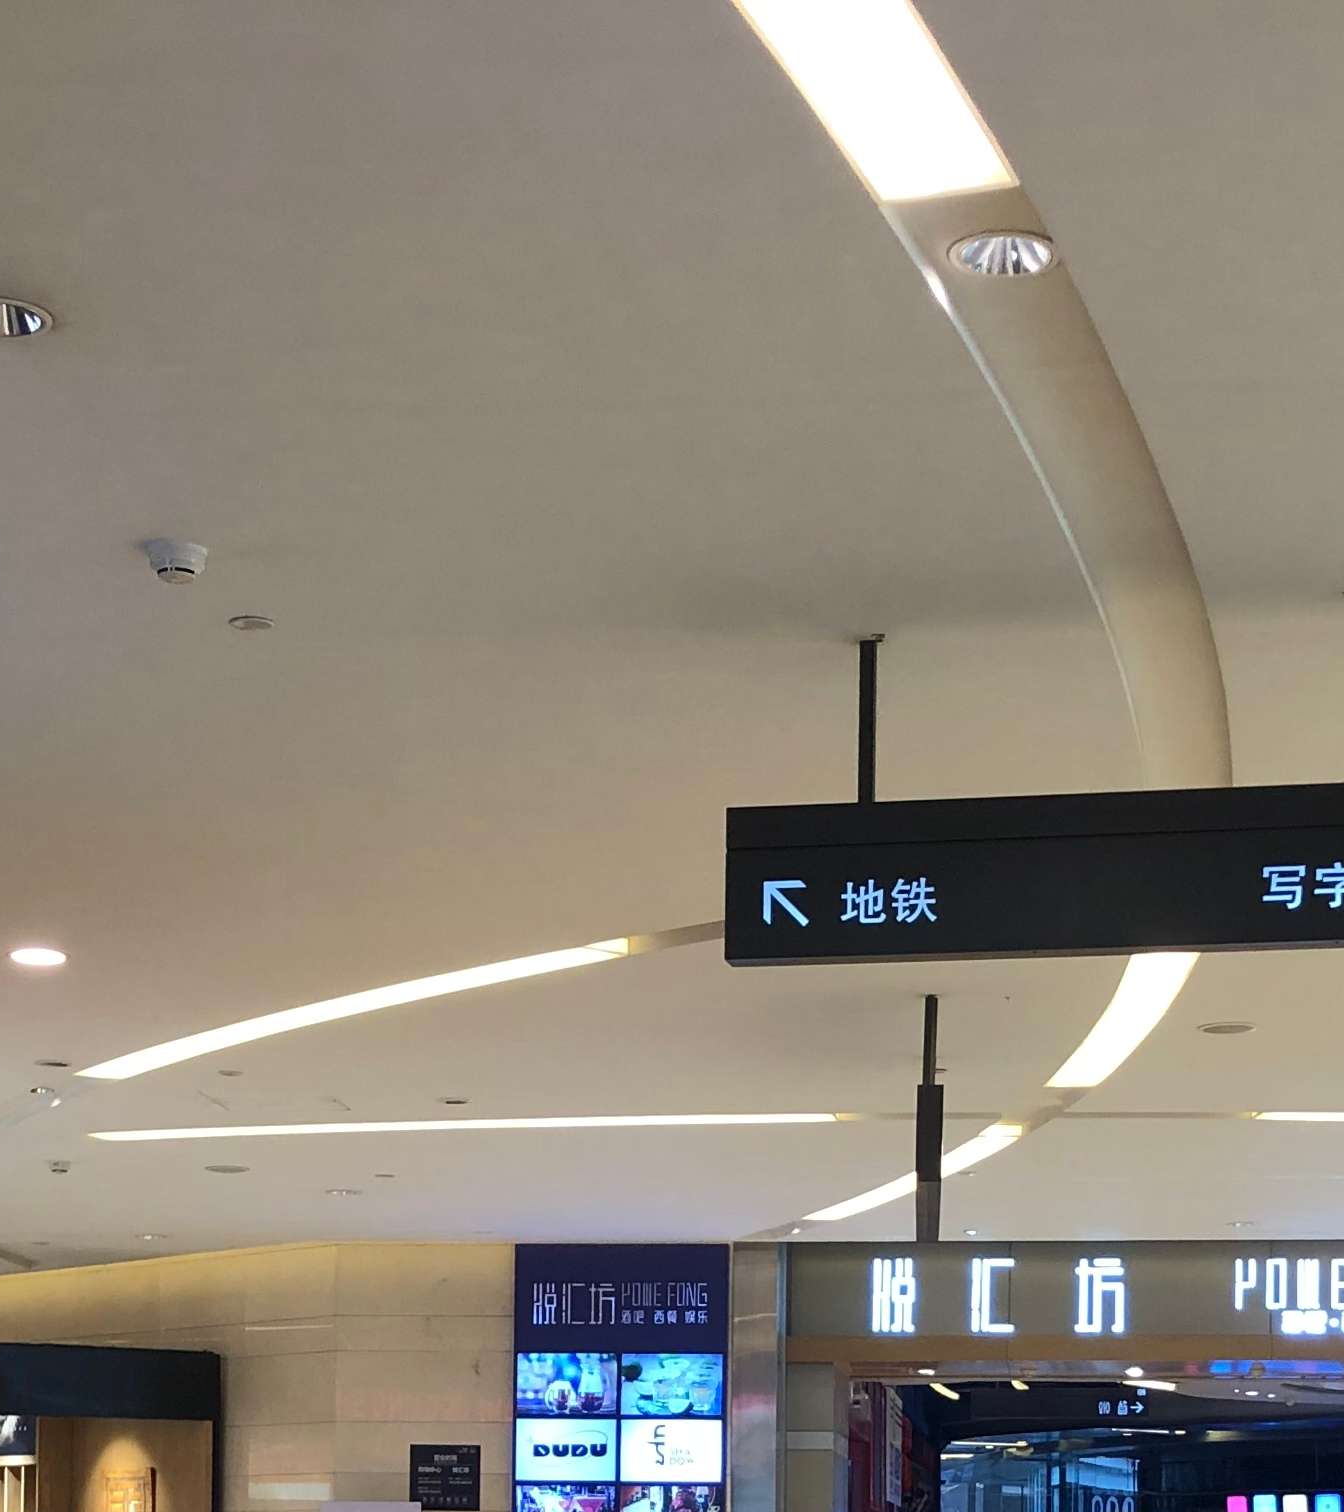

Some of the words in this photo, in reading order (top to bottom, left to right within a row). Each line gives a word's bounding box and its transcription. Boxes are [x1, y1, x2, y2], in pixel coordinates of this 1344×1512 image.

[840, 876, 938, 924] 地铁
[532, 1282, 616, 1325] 悦汇坊
[667, 1282, 709, 1308] FONG
[871, 1256, 1127, 1334] 悦汇坊
[620, 1309, 646, 1325] 酒吧
[653, 1309, 679, 1325] 西餐
[684, 1309, 709, 1325] 娱乐
[532, 1443, 608, 1458] DUDU
